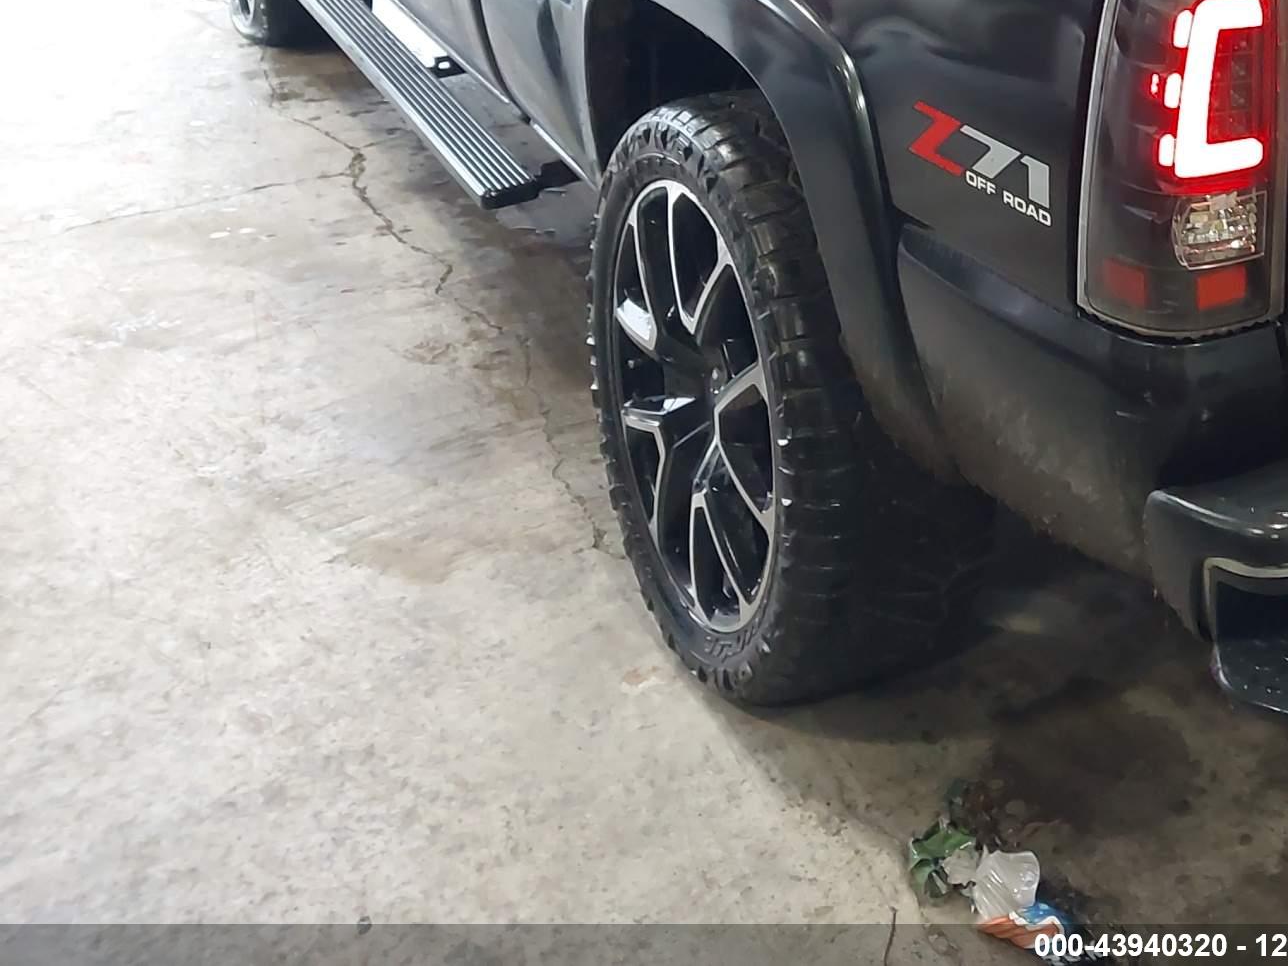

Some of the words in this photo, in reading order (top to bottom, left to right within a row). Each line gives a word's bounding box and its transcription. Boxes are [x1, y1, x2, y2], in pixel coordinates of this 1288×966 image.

[909, 100, 1051, 209] Z71
[965, 170, 997, 195] OFF
[1002, 190, 1052, 227] ROAD
